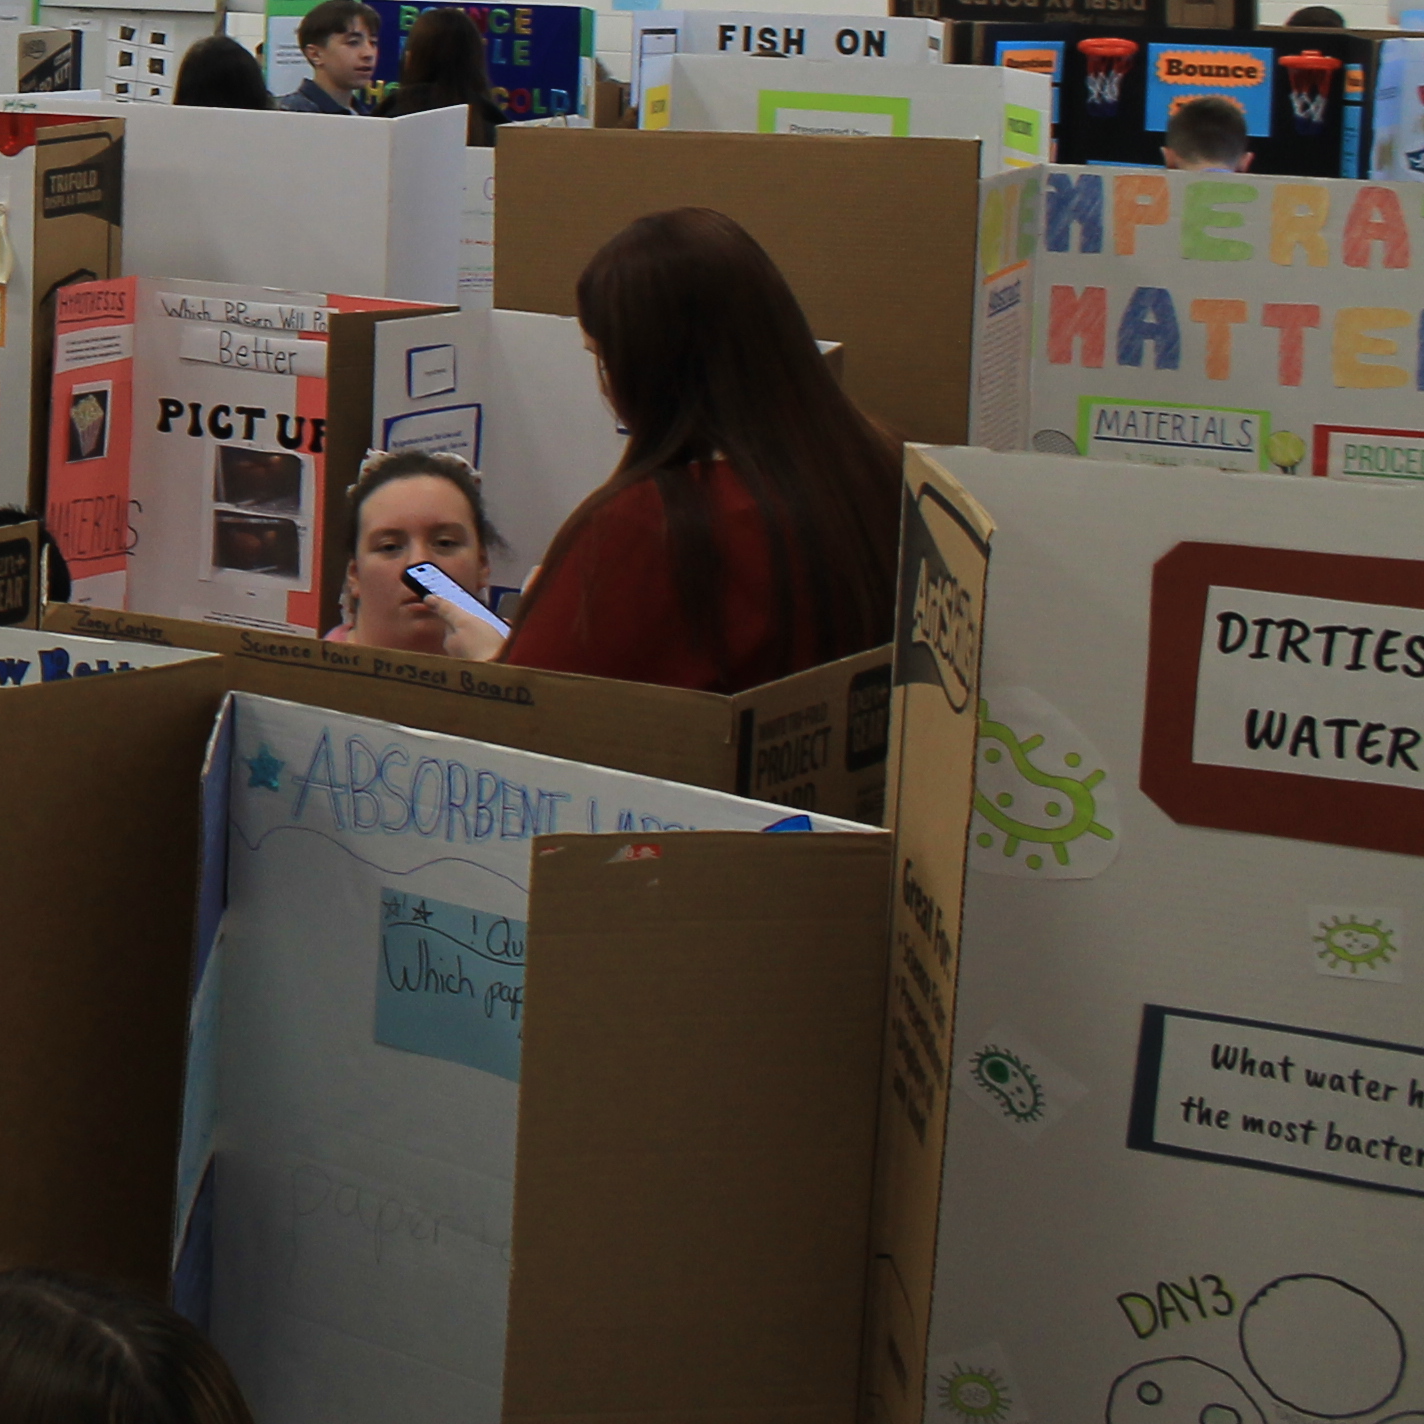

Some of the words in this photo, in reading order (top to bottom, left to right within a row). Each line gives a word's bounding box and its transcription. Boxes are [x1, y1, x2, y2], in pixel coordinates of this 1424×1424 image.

[718, 24, 805, 56] FISH
[835, 29, 887, 58] ON
[1165, 58, 1258, 80] Bounce
[161, 298, 212, 322] Which
[218, 330, 298, 375] Better
[1047, 284, 1424, 390] MATTE
[1094, 408, 1253, 447] MATERIALS
[240, 632, 312, 658] Science
[1244, 707, 1421, 773] WATER
[292, 726, 570, 844] ABSORBENT
[381, 935, 475, 1000] Which
[1211, 1042, 1294, 1087] What
[1304, 1066, 1399, 1106] water
[1179, 1096, 1230, 1133] the
[1241, 1116, 1317, 1147] most
